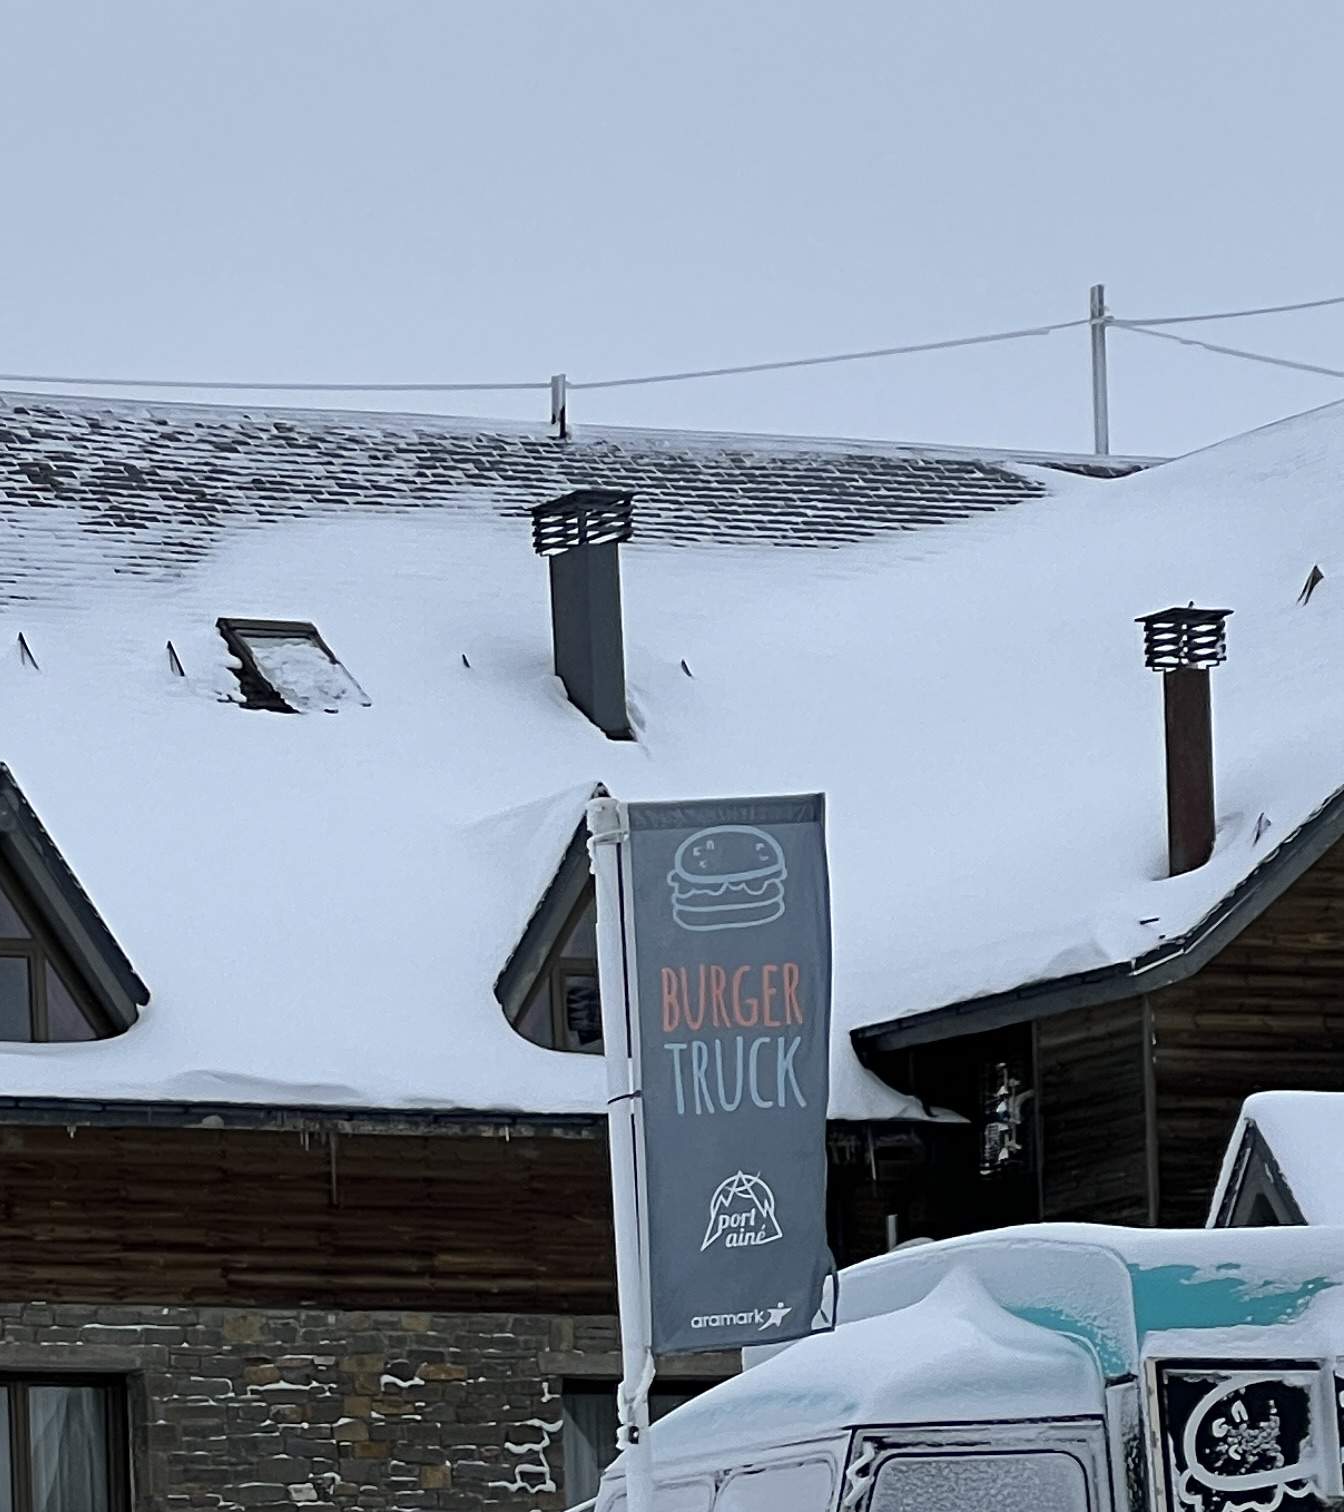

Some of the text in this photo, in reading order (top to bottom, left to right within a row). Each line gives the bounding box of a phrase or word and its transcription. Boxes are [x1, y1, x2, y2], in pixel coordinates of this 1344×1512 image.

[661, 963, 803, 1032] BURGER
[664, 1036, 807, 1115] TRUCK
[719, 1208, 756, 1231] port
[725, 1224, 767, 1247] ainé
[690, 1308, 765, 1328] aramark
